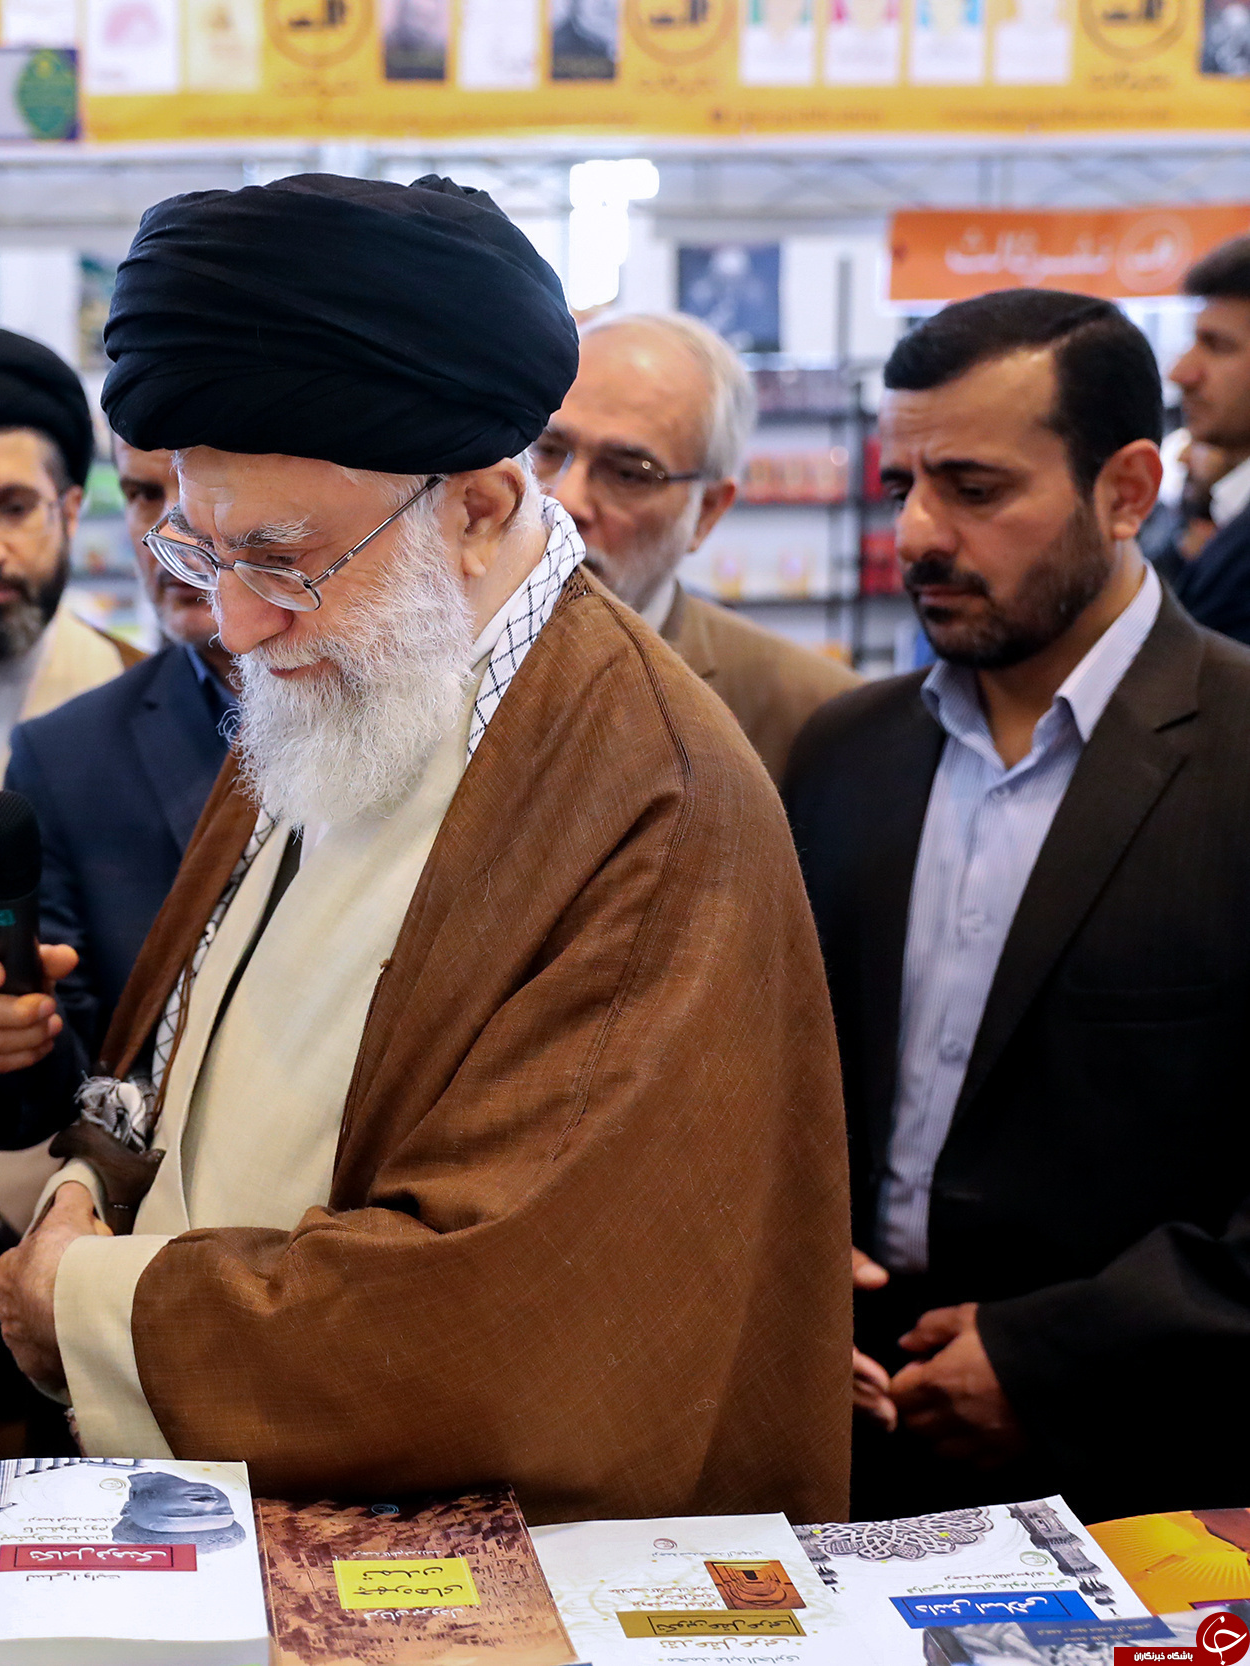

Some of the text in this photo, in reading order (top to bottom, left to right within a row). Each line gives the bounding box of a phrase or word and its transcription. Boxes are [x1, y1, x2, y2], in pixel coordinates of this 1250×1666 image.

[0, 1533, 109, 1543] پیشرفت تمدن
[30, 1547, 167, 1562] تکامل فرهنگ
[83, 1572, 121, 1582] وایت
[362, 1566, 443, 1581] تمدن
[915, 1596, 1048, 1616] دانش اسلامی
[656, 1619, 791, 1632] تکوین عقل عربی
[659, 1637, 789, 1651] نقد عقل عربی
